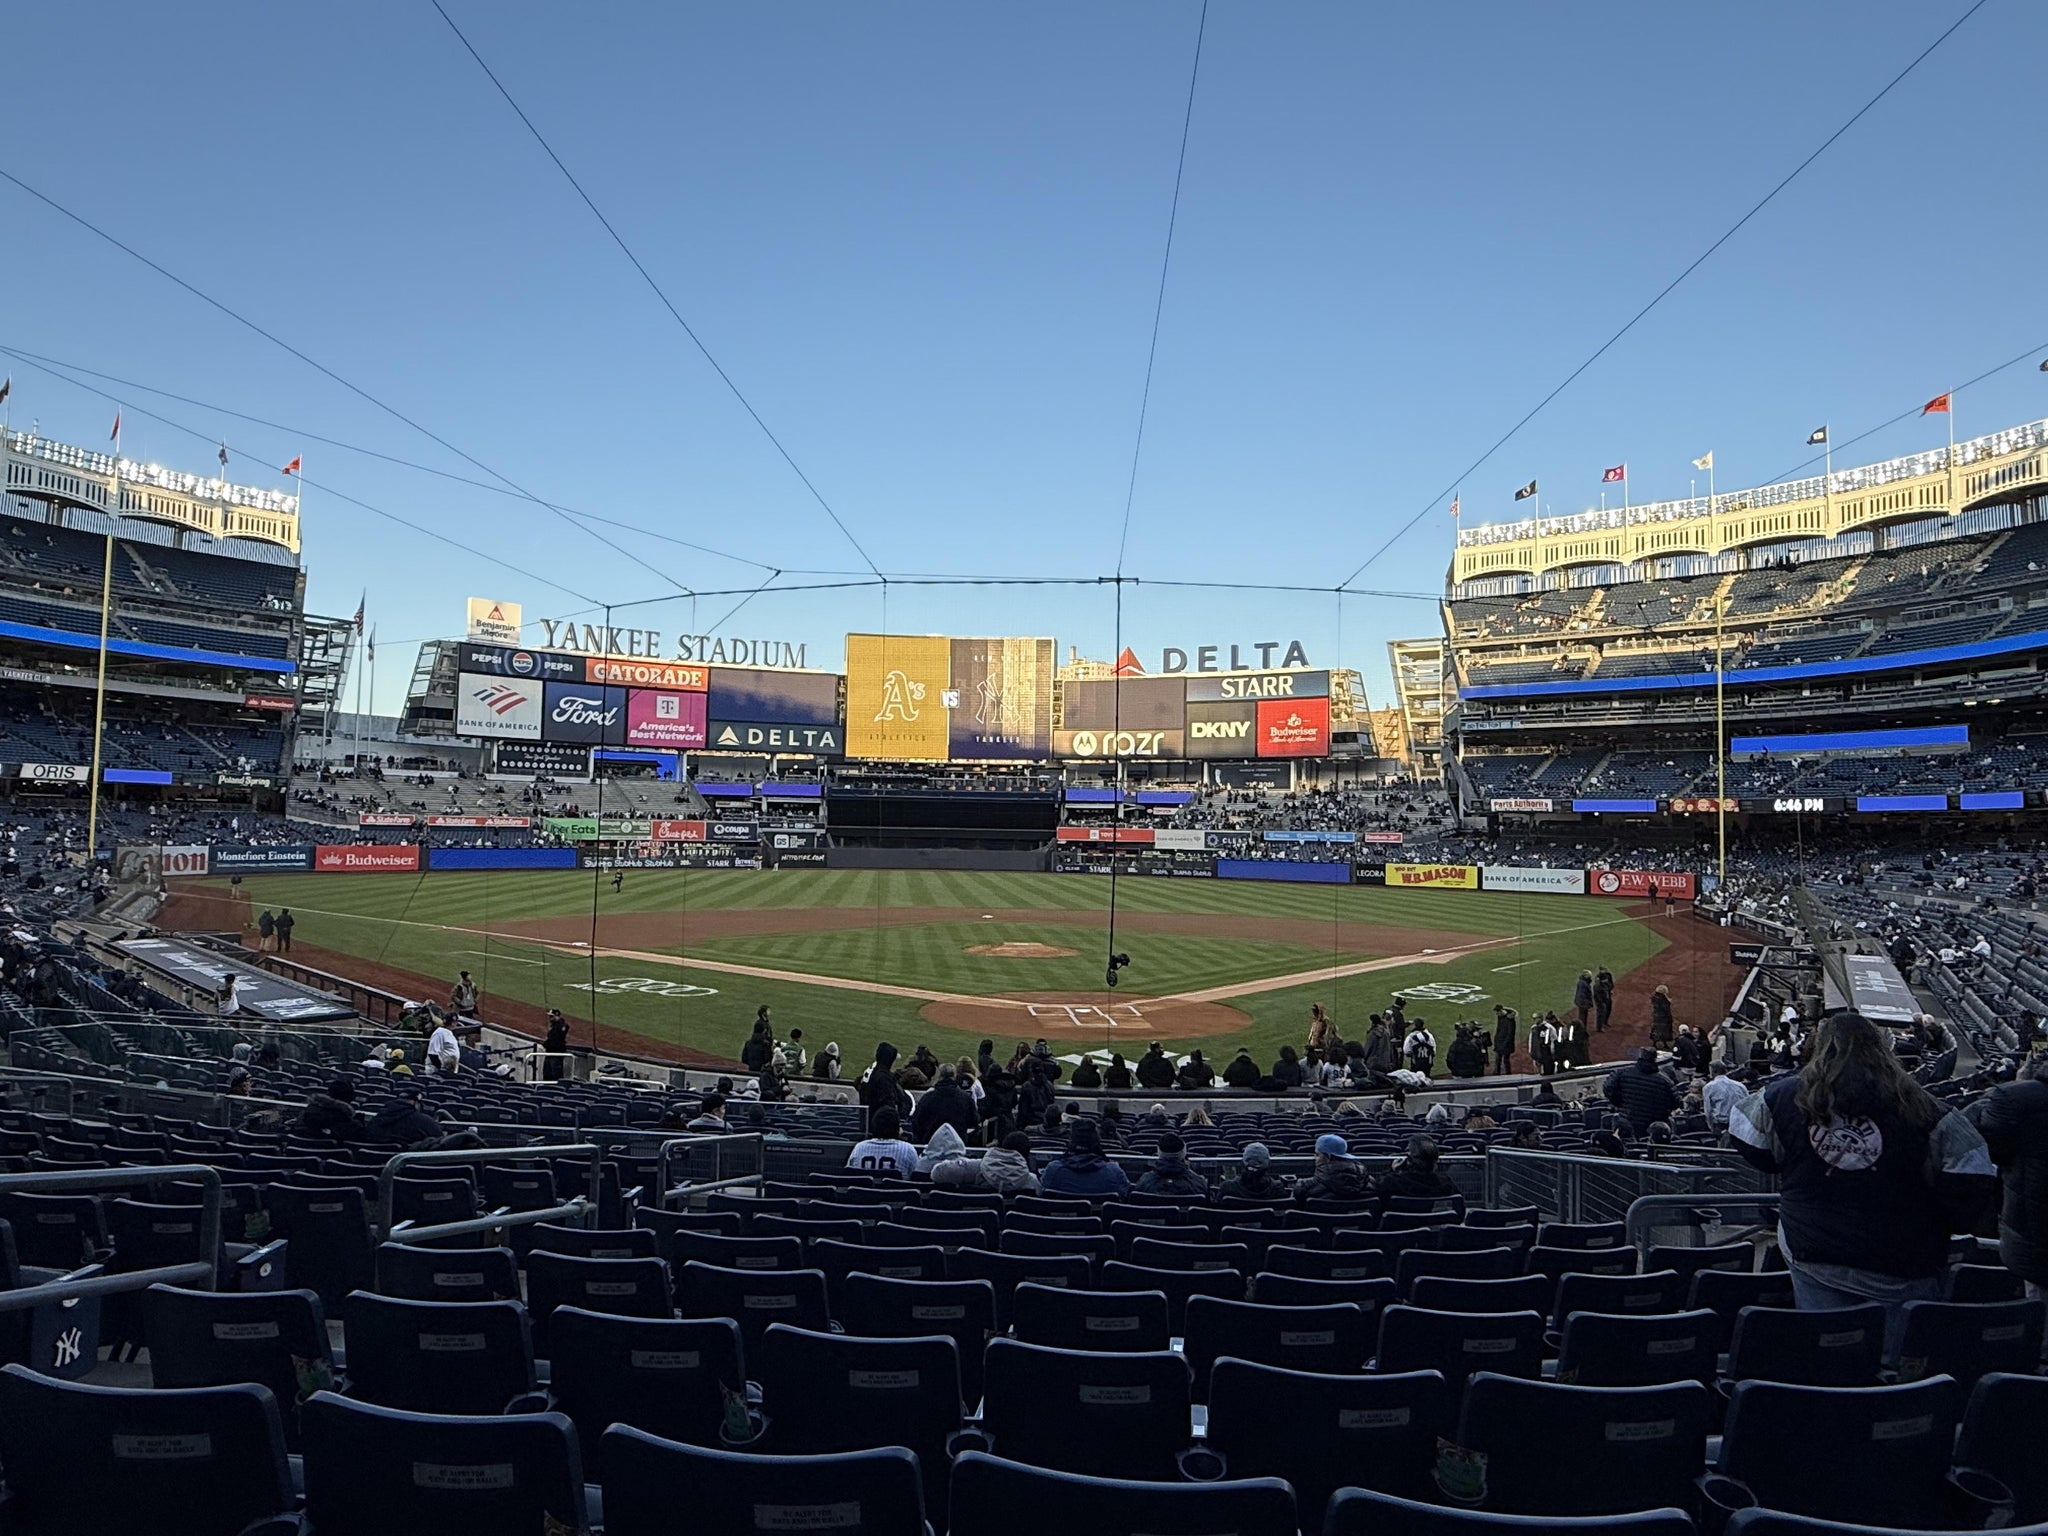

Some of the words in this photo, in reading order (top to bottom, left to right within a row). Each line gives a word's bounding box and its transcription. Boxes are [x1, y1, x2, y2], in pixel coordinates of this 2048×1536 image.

[476, 620, 516, 633] Benjamin
[480, 629, 508, 639] Moore
[540, 618, 660, 659] YANKEE
[676, 634, 807, 669] STADIUM
[471, 653, 502, 665] PEPSI
[1162, 640, 1309, 673] DELTA
[543, 661, 573, 672] PEPSI
[593, 664, 702, 687] GATORADE
[1221, 675, 1294, 698] STARR
[942, 691, 958, 707] VS
[552, 695, 619, 726] Ford
[499, 723, 538, 731] AMERICA
[640, 722, 695, 732] America's
[1191, 721, 1251, 738] DKNY
[1269, 727, 1318, 736] Budweiser
[629, 730, 654, 740] Best
[656, 732, 704, 742] Network
[748, 728, 835, 748] DELTA
[1102, 732, 1165, 756] razr
[33, 765, 75, 779] ORIS
[218, 775, 244, 784] Poland
[245, 776, 270, 787] Spring
[1774, 798, 1802, 811] 6:46
[1804, 798, 1823, 811] PM
[572, 824, 596, 835] Eats
[724, 826, 748, 834] coupa
[217, 852, 266, 861] Montefiore
[268, 851, 306, 861] Einstein
[345, 853, 415, 866] Budweiser
[1356, 870, 1385, 878] LEGORA
[1522, 877, 1562, 885] AMERICA
[1648, 876, 1687, 888] WEBB
[55, 1327, 82, 1367] NY
